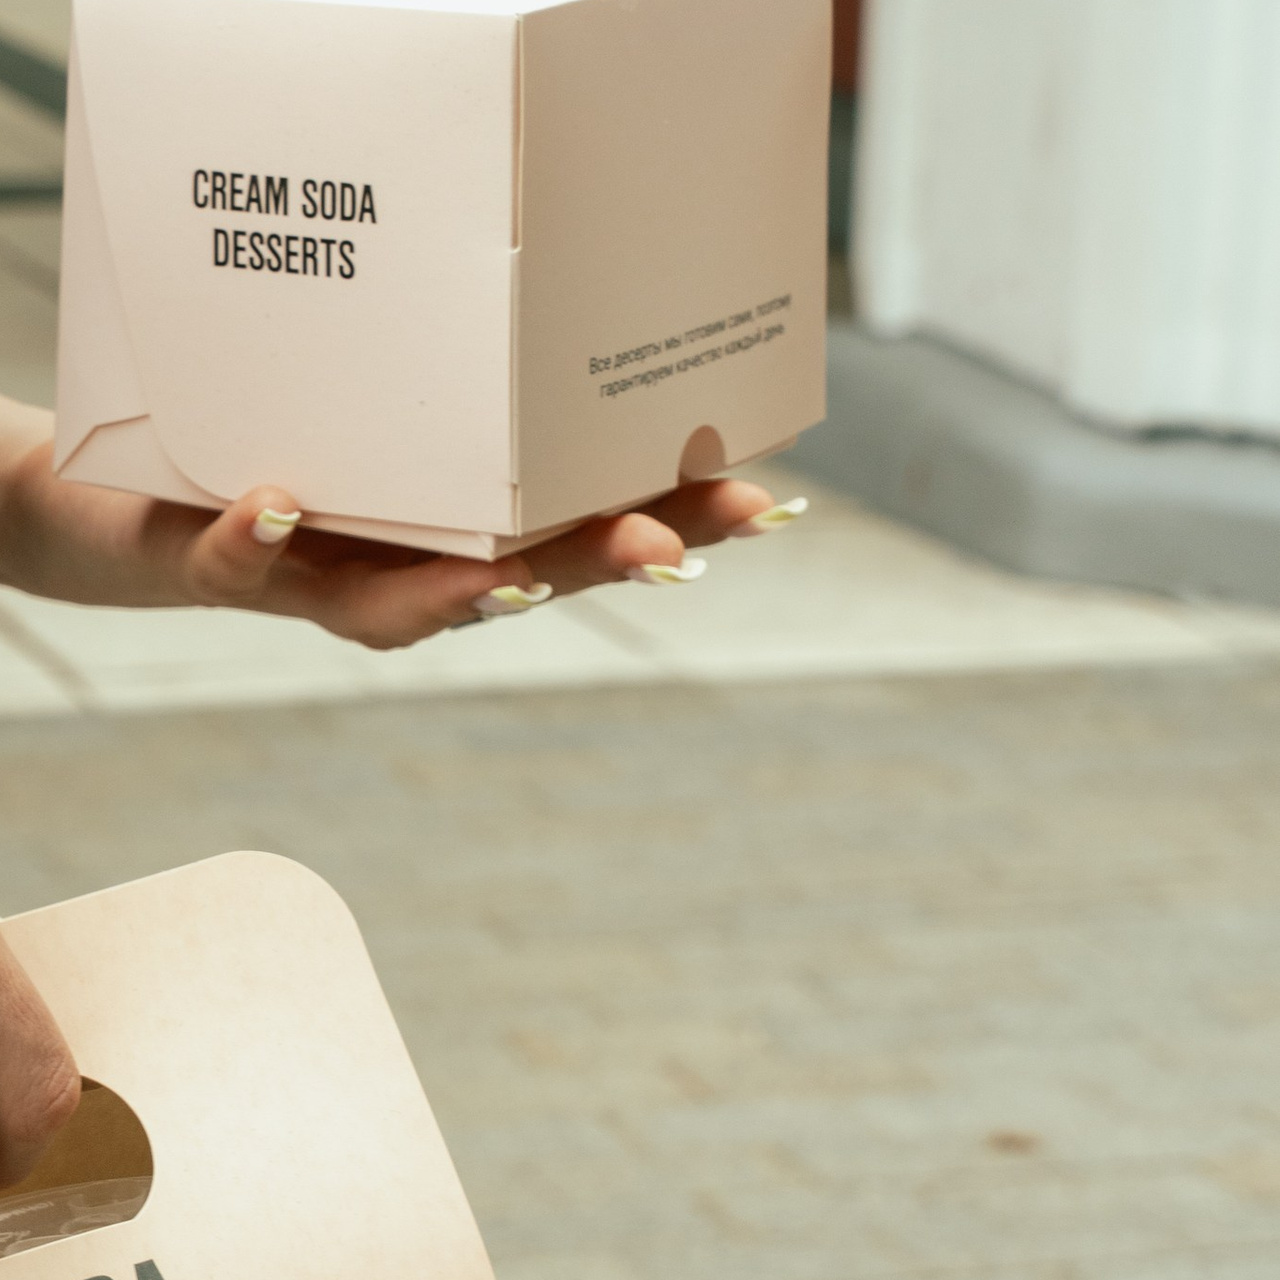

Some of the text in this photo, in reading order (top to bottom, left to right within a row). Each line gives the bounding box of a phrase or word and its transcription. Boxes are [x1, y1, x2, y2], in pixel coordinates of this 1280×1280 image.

[193, 168, 378, 225] CREAM SODA
[213, 227, 356, 280] DESSERTS
[589, 356, 612, 375] Все
[613, 342, 662, 370] десерты
[664, 336, 682, 351] мы
